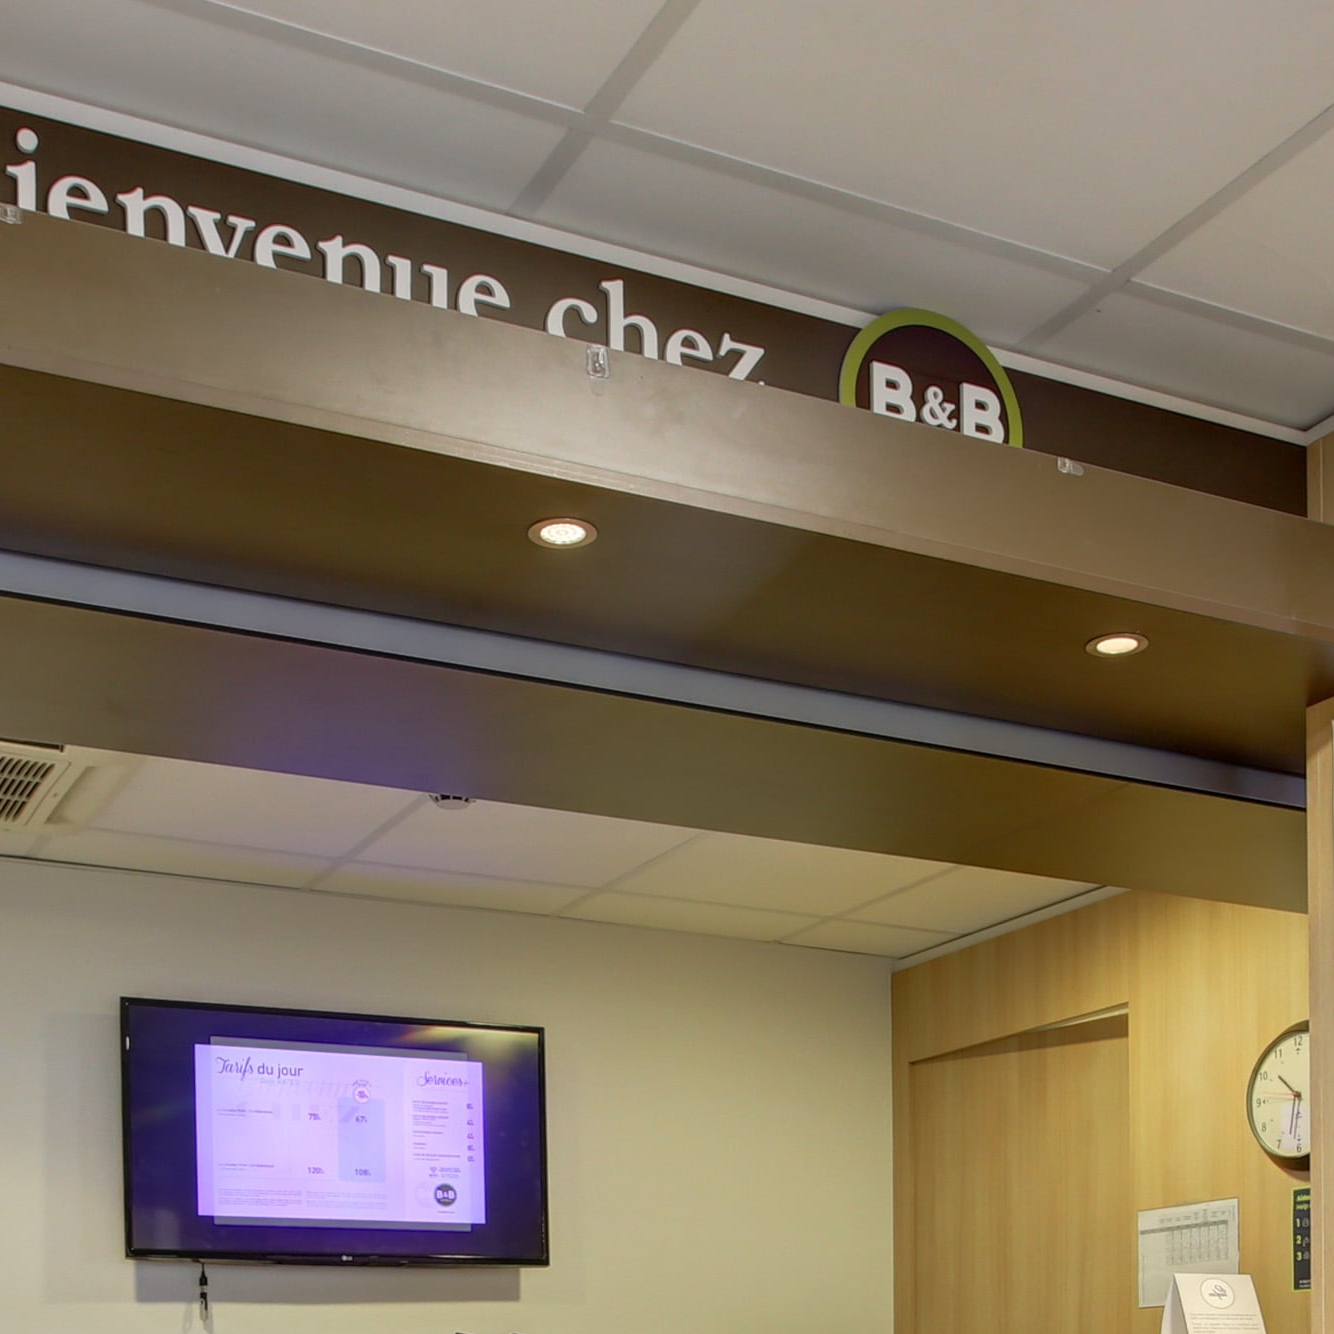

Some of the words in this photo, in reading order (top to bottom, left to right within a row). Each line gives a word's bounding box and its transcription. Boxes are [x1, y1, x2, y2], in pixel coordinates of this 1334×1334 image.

[546, 279, 766, 385] chez
[869, 360, 1005, 446] B&B
[1293, 1035, 1302, 1046] 12
[1274, 1049, 1283, 1059] 11
[216, 1056, 253, 1081] Tarifs
[257, 1063, 273, 1075] du
[277, 1064, 303, 1078] jour
[1259, 1071, 1268, 1081] 10
[1256, 1098, 1261, 1107] 9
[1261, 1123, 1266, 1132] 8
[1277, 1140, 1281, 1149] 7
[1297, 1143, 1302, 1153] 6
[1296, 1218, 1300, 1227] 1
[1296, 1235, 1302, 1244] 2
[1296, 1251, 1302, 1261] 3
